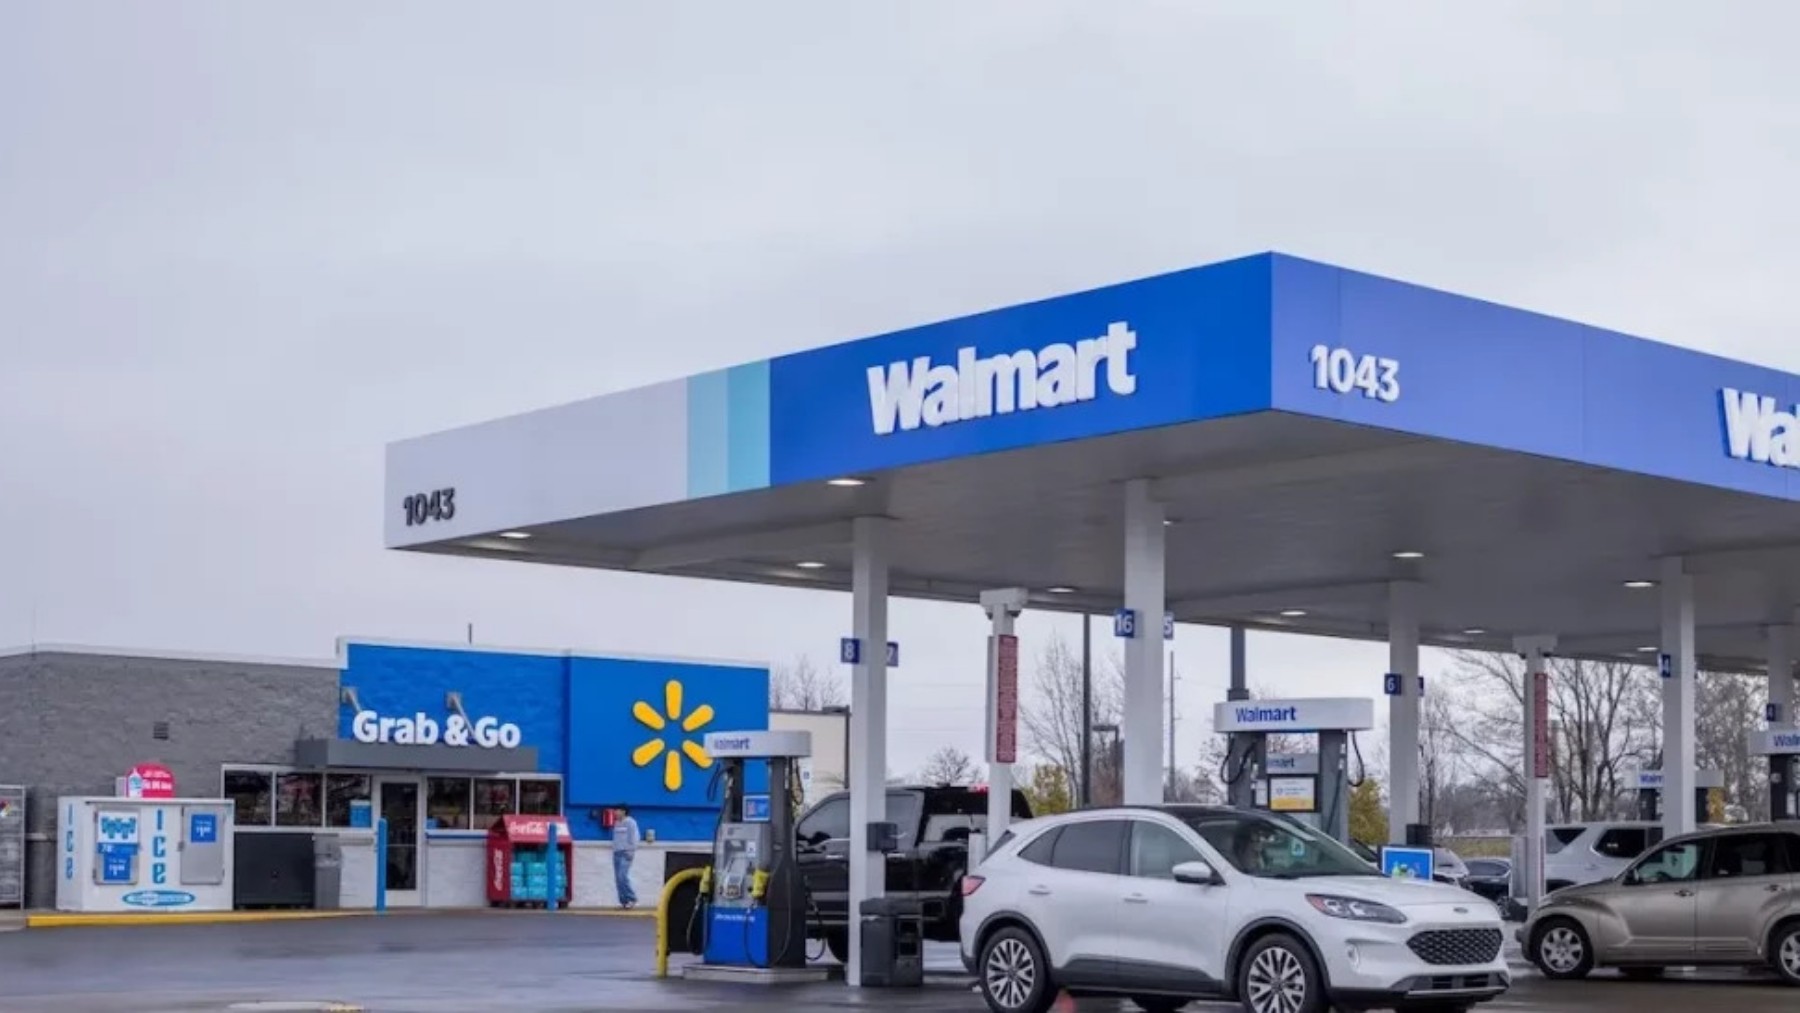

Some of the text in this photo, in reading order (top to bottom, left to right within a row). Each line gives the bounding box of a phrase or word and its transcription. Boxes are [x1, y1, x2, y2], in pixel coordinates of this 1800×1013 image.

[867, 321, 1136, 434] Walmart
[1310, 344, 1400, 402] 1043
[403, 487, 455, 527] 1043
[1116, 613, 1133, 634] 16
[844, 642, 854, 661] 8
[1387, 677, 1396, 692] 6
[1236, 706, 1297, 723] Walmart
[352, 709, 521, 749] Grab & Go
[1773, 734, 1800, 747] Wal
